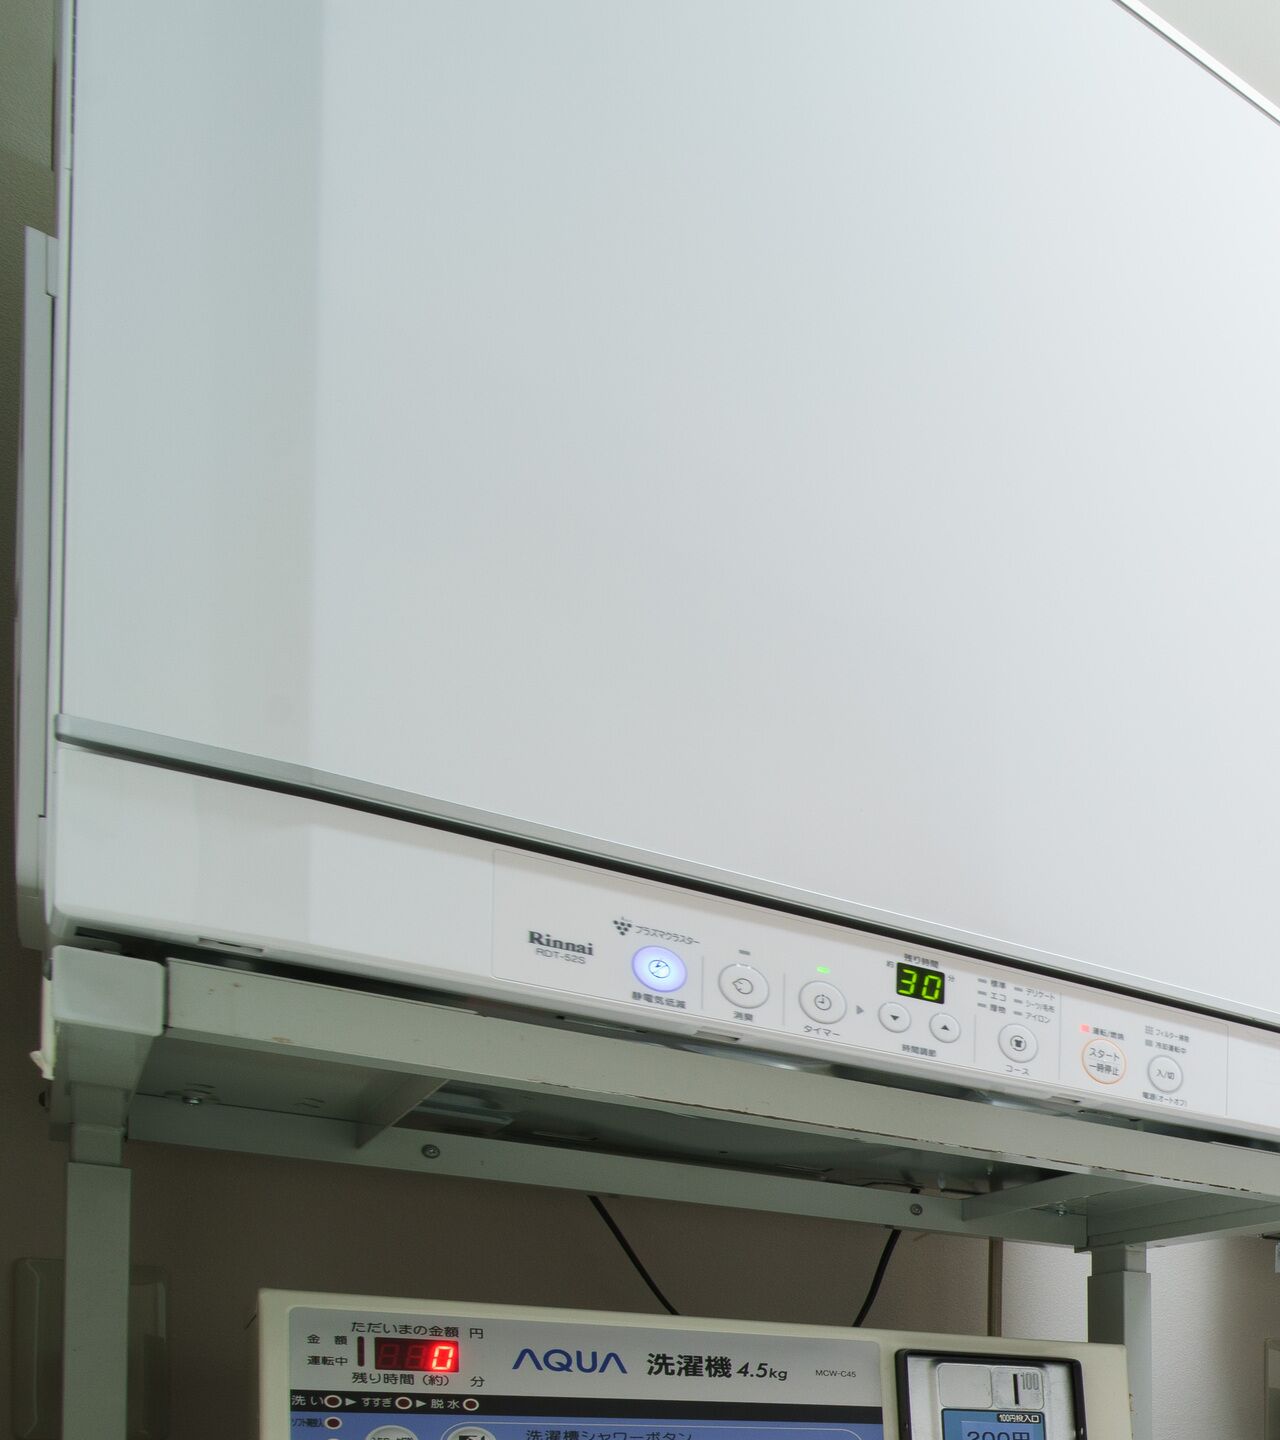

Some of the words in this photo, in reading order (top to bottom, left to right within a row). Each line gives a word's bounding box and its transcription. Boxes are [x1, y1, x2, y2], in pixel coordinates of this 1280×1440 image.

[528, 930, 594, 956] Rinnai
[535, 947, 587, 966] RDT-52S
[904, 955, 939, 973] 残り時間
[897, 969, 942, 1001] 30
[990, 992, 1007, 1002] エコ
[1025, 987, 1056, 1001] デリケート
[1025, 1012, 1051, 1024] アイロン
[803, 1025, 841, 1037] タイマー
[1089, 1047, 1121, 1062] スタート
[1005, 1064, 1030, 1076] コース
[1088, 1063, 1120, 1077] 一時停止
[1156, 1068, 1176, 1081] 入/切
[351, 1321, 460, 1338] ただいまの金額
[469, 1327, 484, 1339] 円
[307, 1355, 348, 1367] 運転中
[431, 1345, 455, 1371] 0
[511, 1348, 629, 1375] AQUA
[647, 1352, 733, 1379] 洗濯機
[736, 1362, 789, 1382] 4.5kg
[815, 1369, 858, 1378] MCW-C45
[469, 1376, 485, 1387] 分
[1020, 1372, 1040, 1391] 100
[291, 1395, 324, 1407] 洗い
[361, 1397, 392, 1408] すすぎ
[430, 1398, 461, 1410] 脱水
